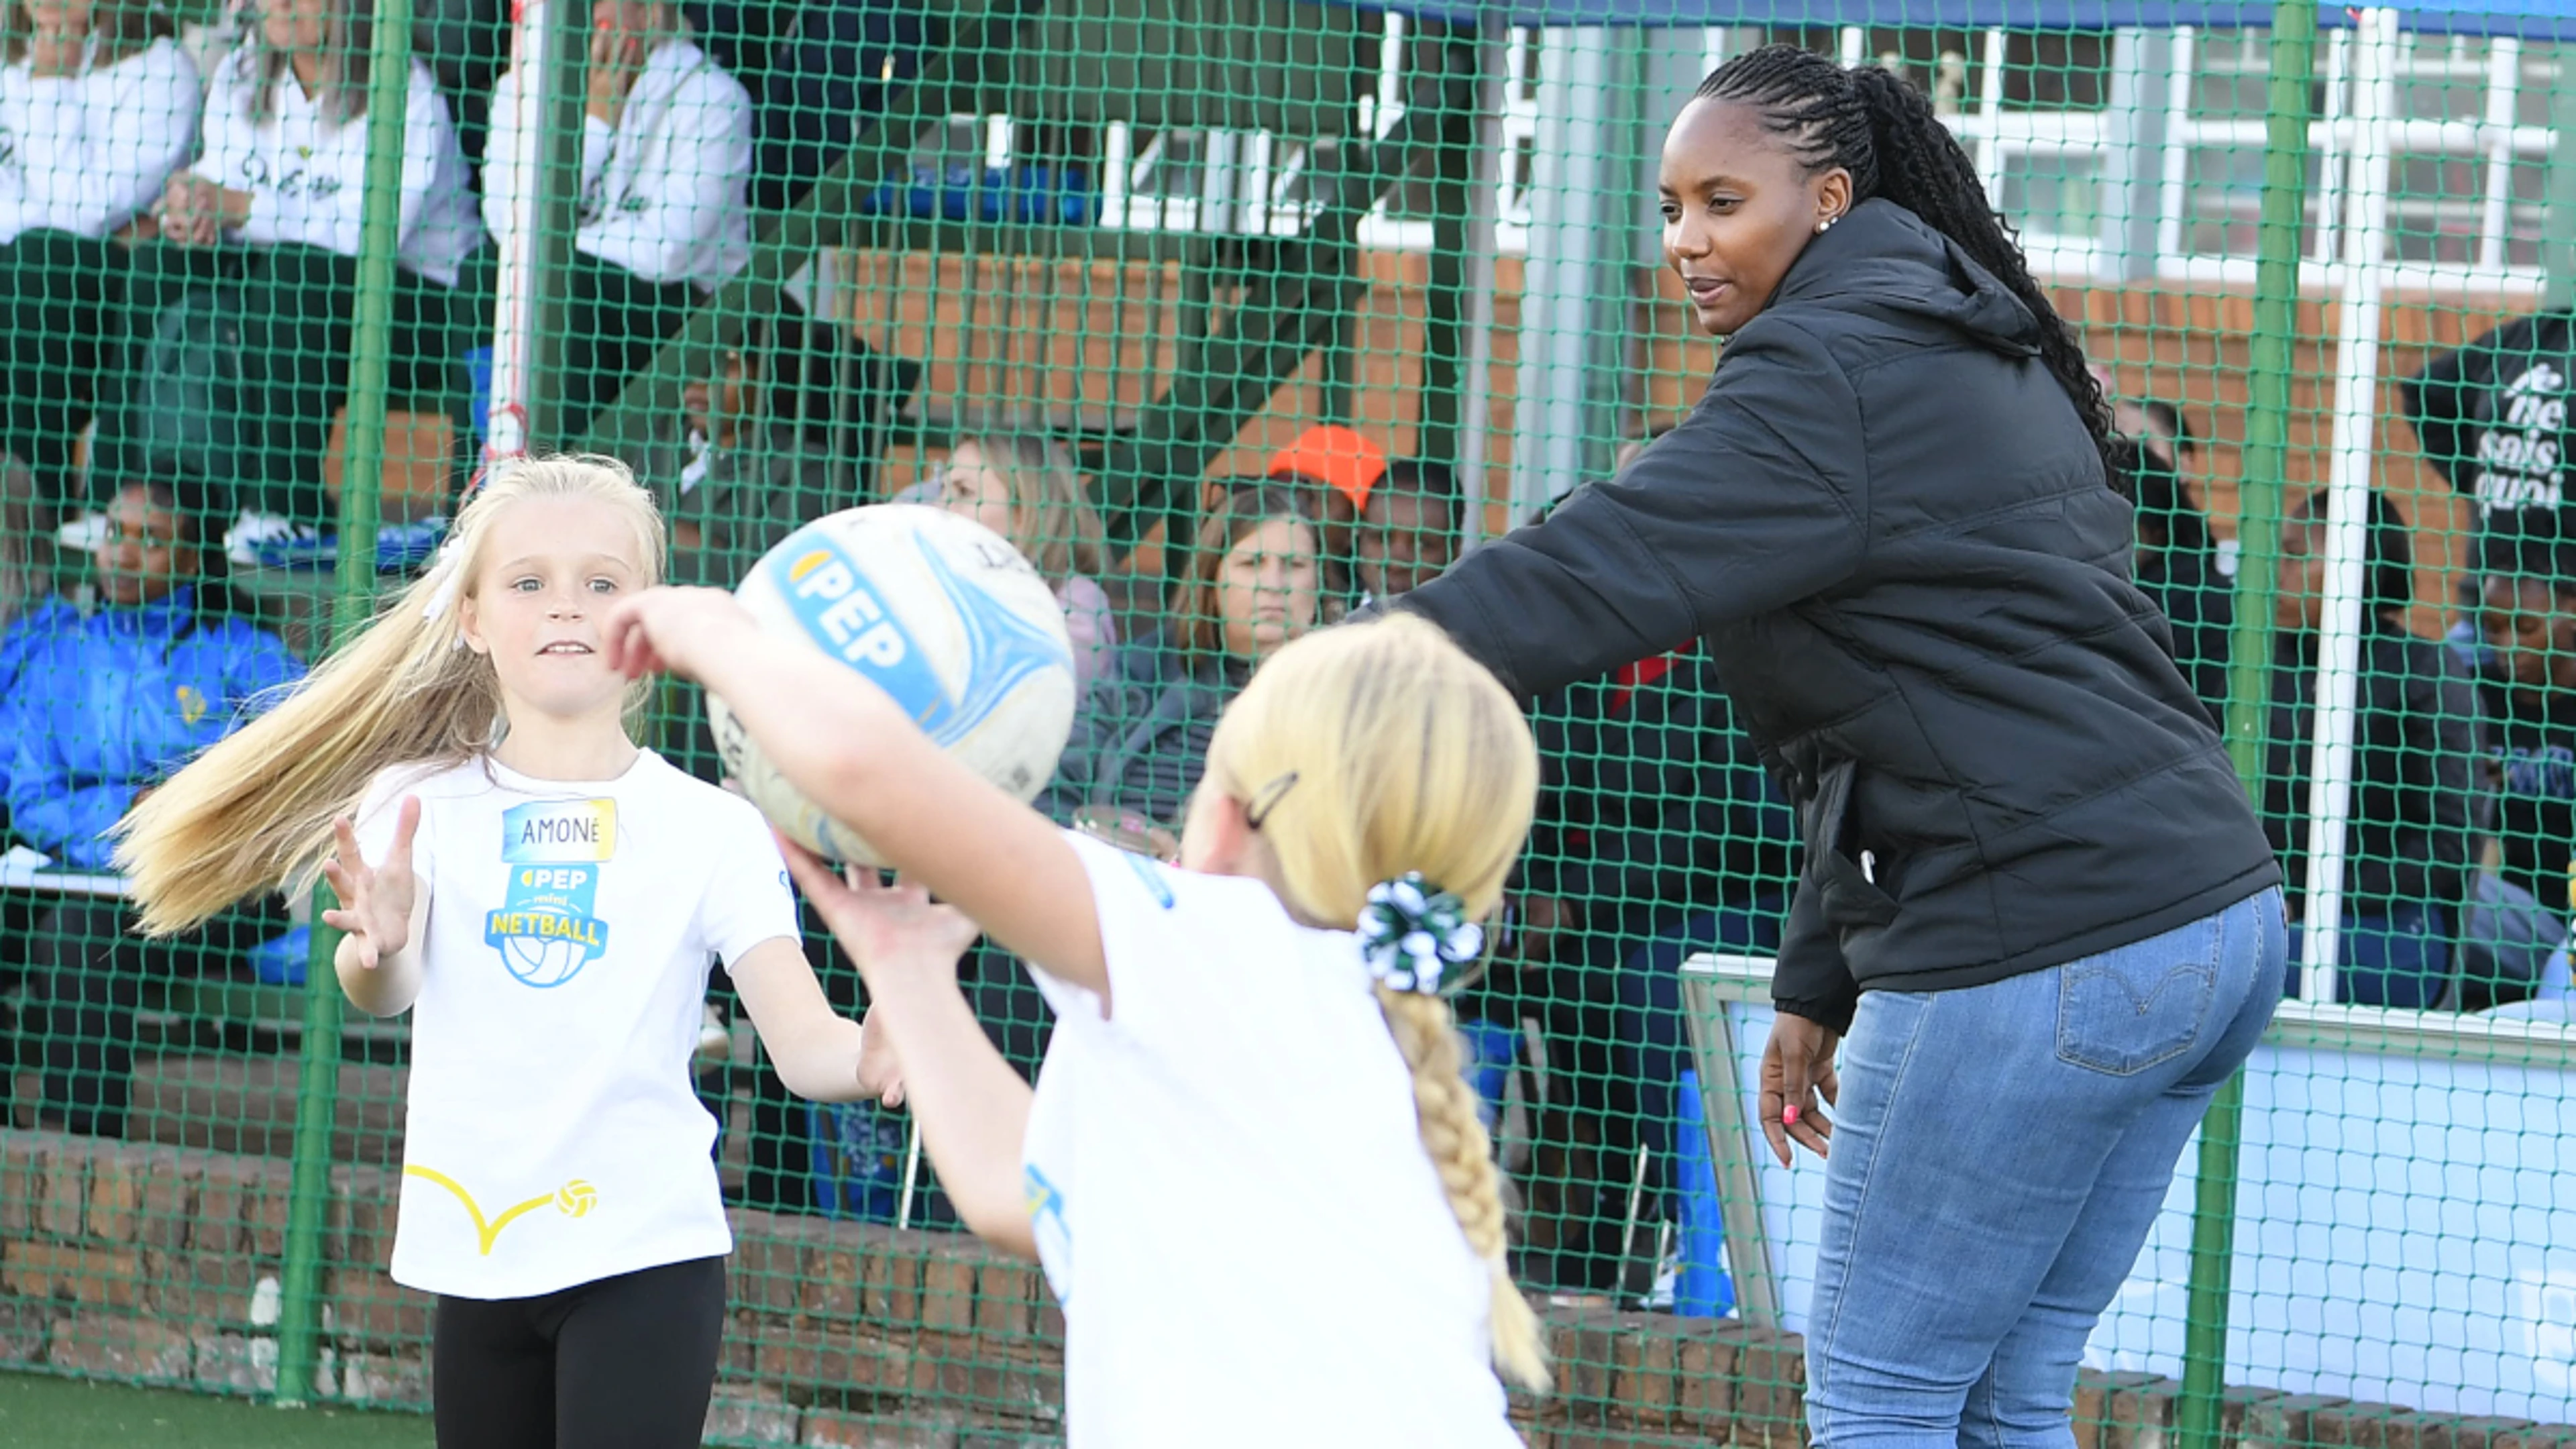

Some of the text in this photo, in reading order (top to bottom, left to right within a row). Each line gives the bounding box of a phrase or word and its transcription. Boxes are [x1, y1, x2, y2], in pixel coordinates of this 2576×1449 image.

[2507, 392, 2568, 431] ne
[2477, 427, 2559, 476] sais
[2475, 471, 2565, 521] quoi
[796, 559, 906, 668] PEP
[534, 869, 588, 890] PEP
[490, 912, 600, 946] NETBALL
